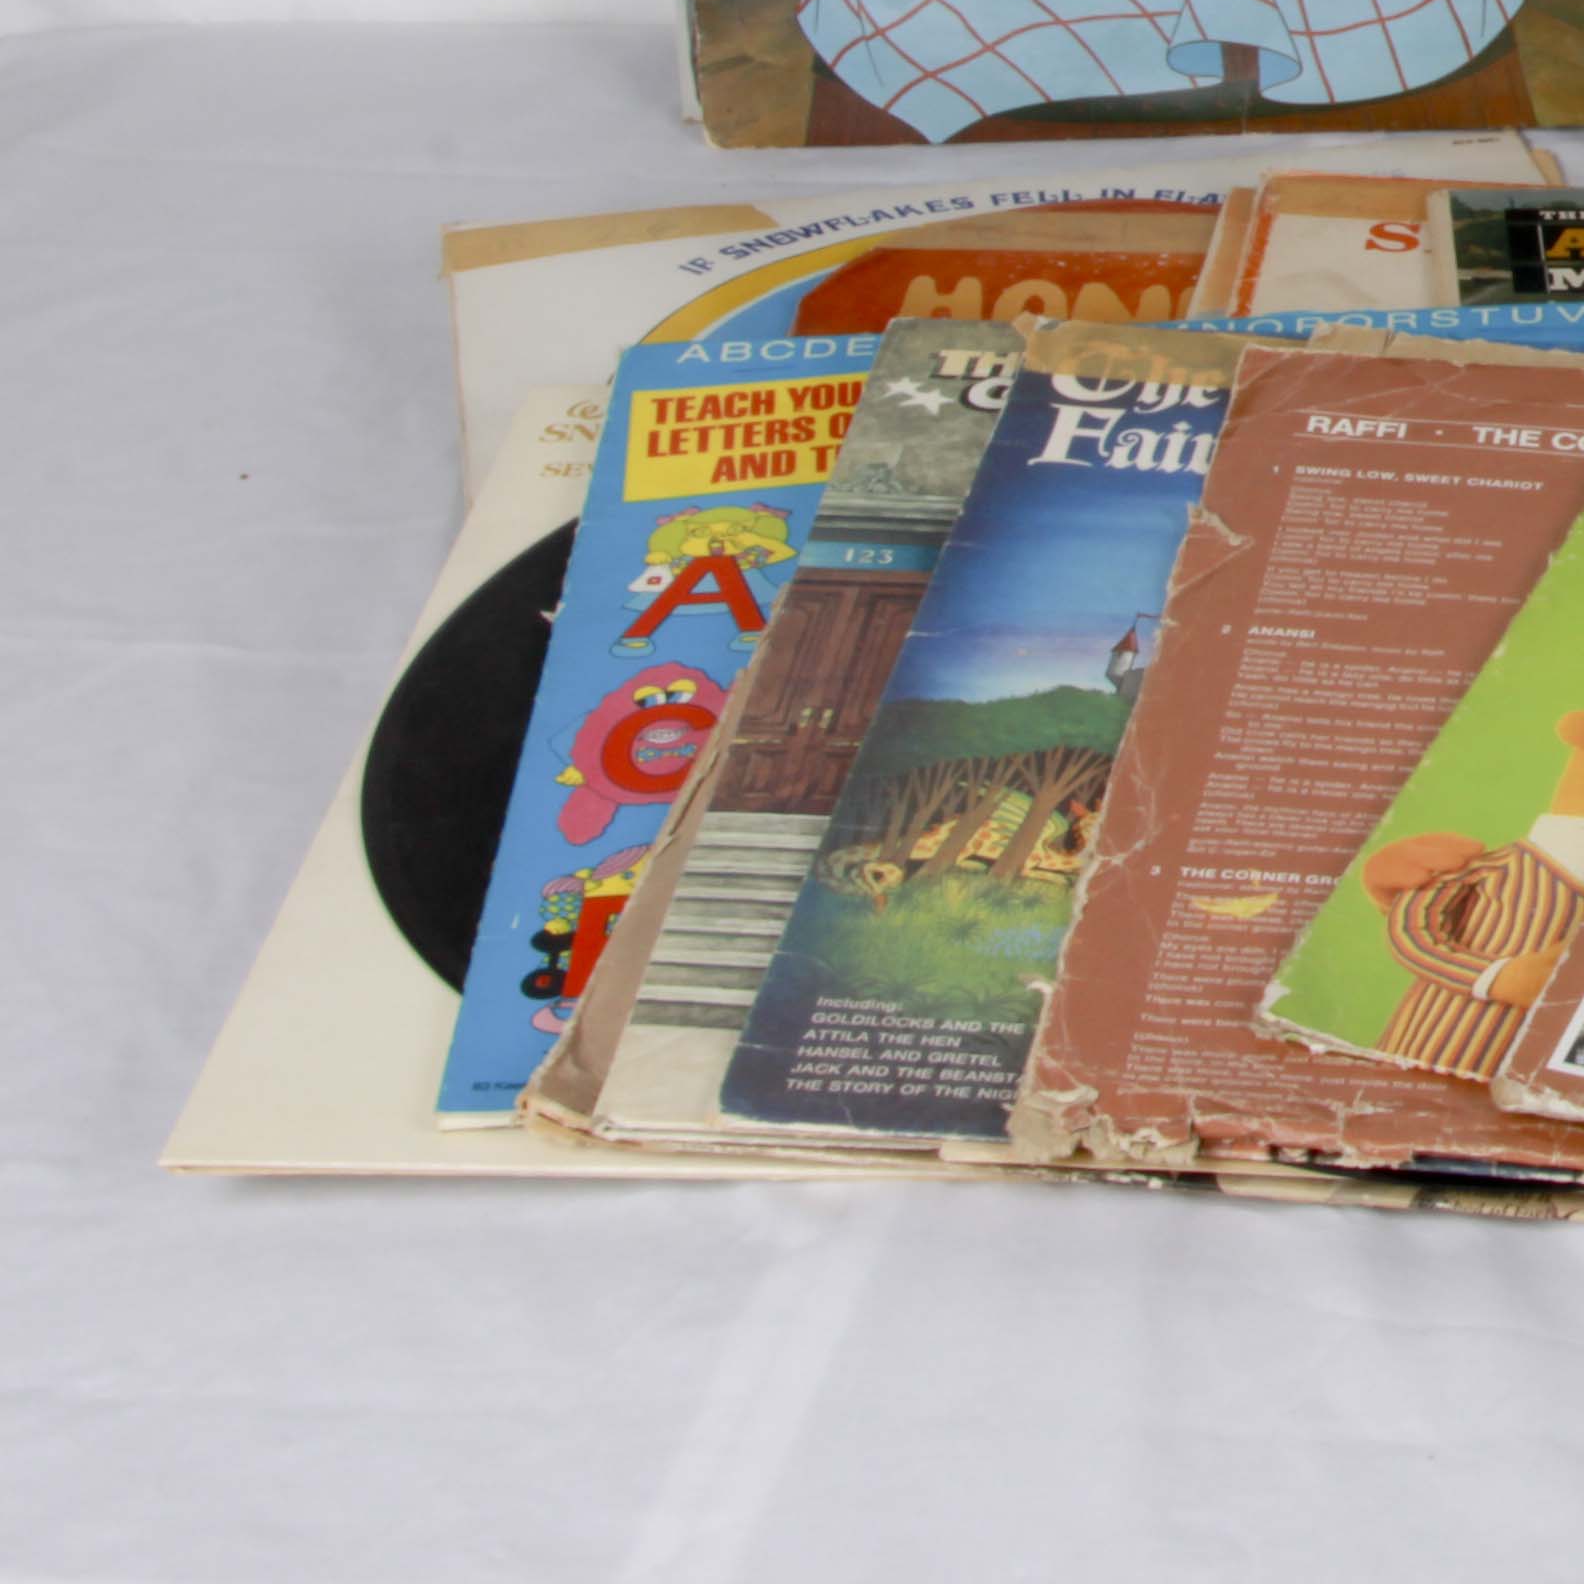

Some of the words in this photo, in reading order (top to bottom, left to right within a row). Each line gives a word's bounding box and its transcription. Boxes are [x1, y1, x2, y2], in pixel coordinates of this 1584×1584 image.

[989, 189, 1083, 207] FELL
[1100, 188, 1136, 200] IN
[1364, 221, 1422, 253] S
[650, 389, 776, 426] TEACH
[646, 415, 817, 458] LETTERS
[1305, 415, 1409, 440] RAFFI
[1472, 425, 1544, 450] THE
[709, 448, 797, 484] AND
[1294, 465, 1352, 479] SWING
[1403, 472, 1463, 487] SWEET
[1466, 476, 1545, 492] CHARIOT
[844, 547, 896, 566] 123
[1247, 625, 1317, 639] ANANSI
[1179, 866, 1218, 879] THE
[1219, 868, 1302, 885] CORNER
[810, 1012, 935, 1030] GOLDILOCKS
[939, 1019, 983, 1033] AND
[989, 1021, 1026, 1035] THE
[801, 1028, 870, 1043] ATTILA
[877, 1032, 915, 1046] THE
[919, 1034, 963, 1048] HEN
[797, 1045, 873, 1060] HANSEL
[879, 1049, 922, 1063] AND
[927, 1051, 1002, 1067] GRETEL
[790, 1062, 842, 1076] JACK
[847, 1065, 891, 1078] AND
[895, 1066, 933, 1080] THE
[785, 1078, 825, 1092] THE
[828, 1080, 895, 1095] STORY
[899, 1082, 926, 1096] OF
[933, 1085, 973, 1100] THE
